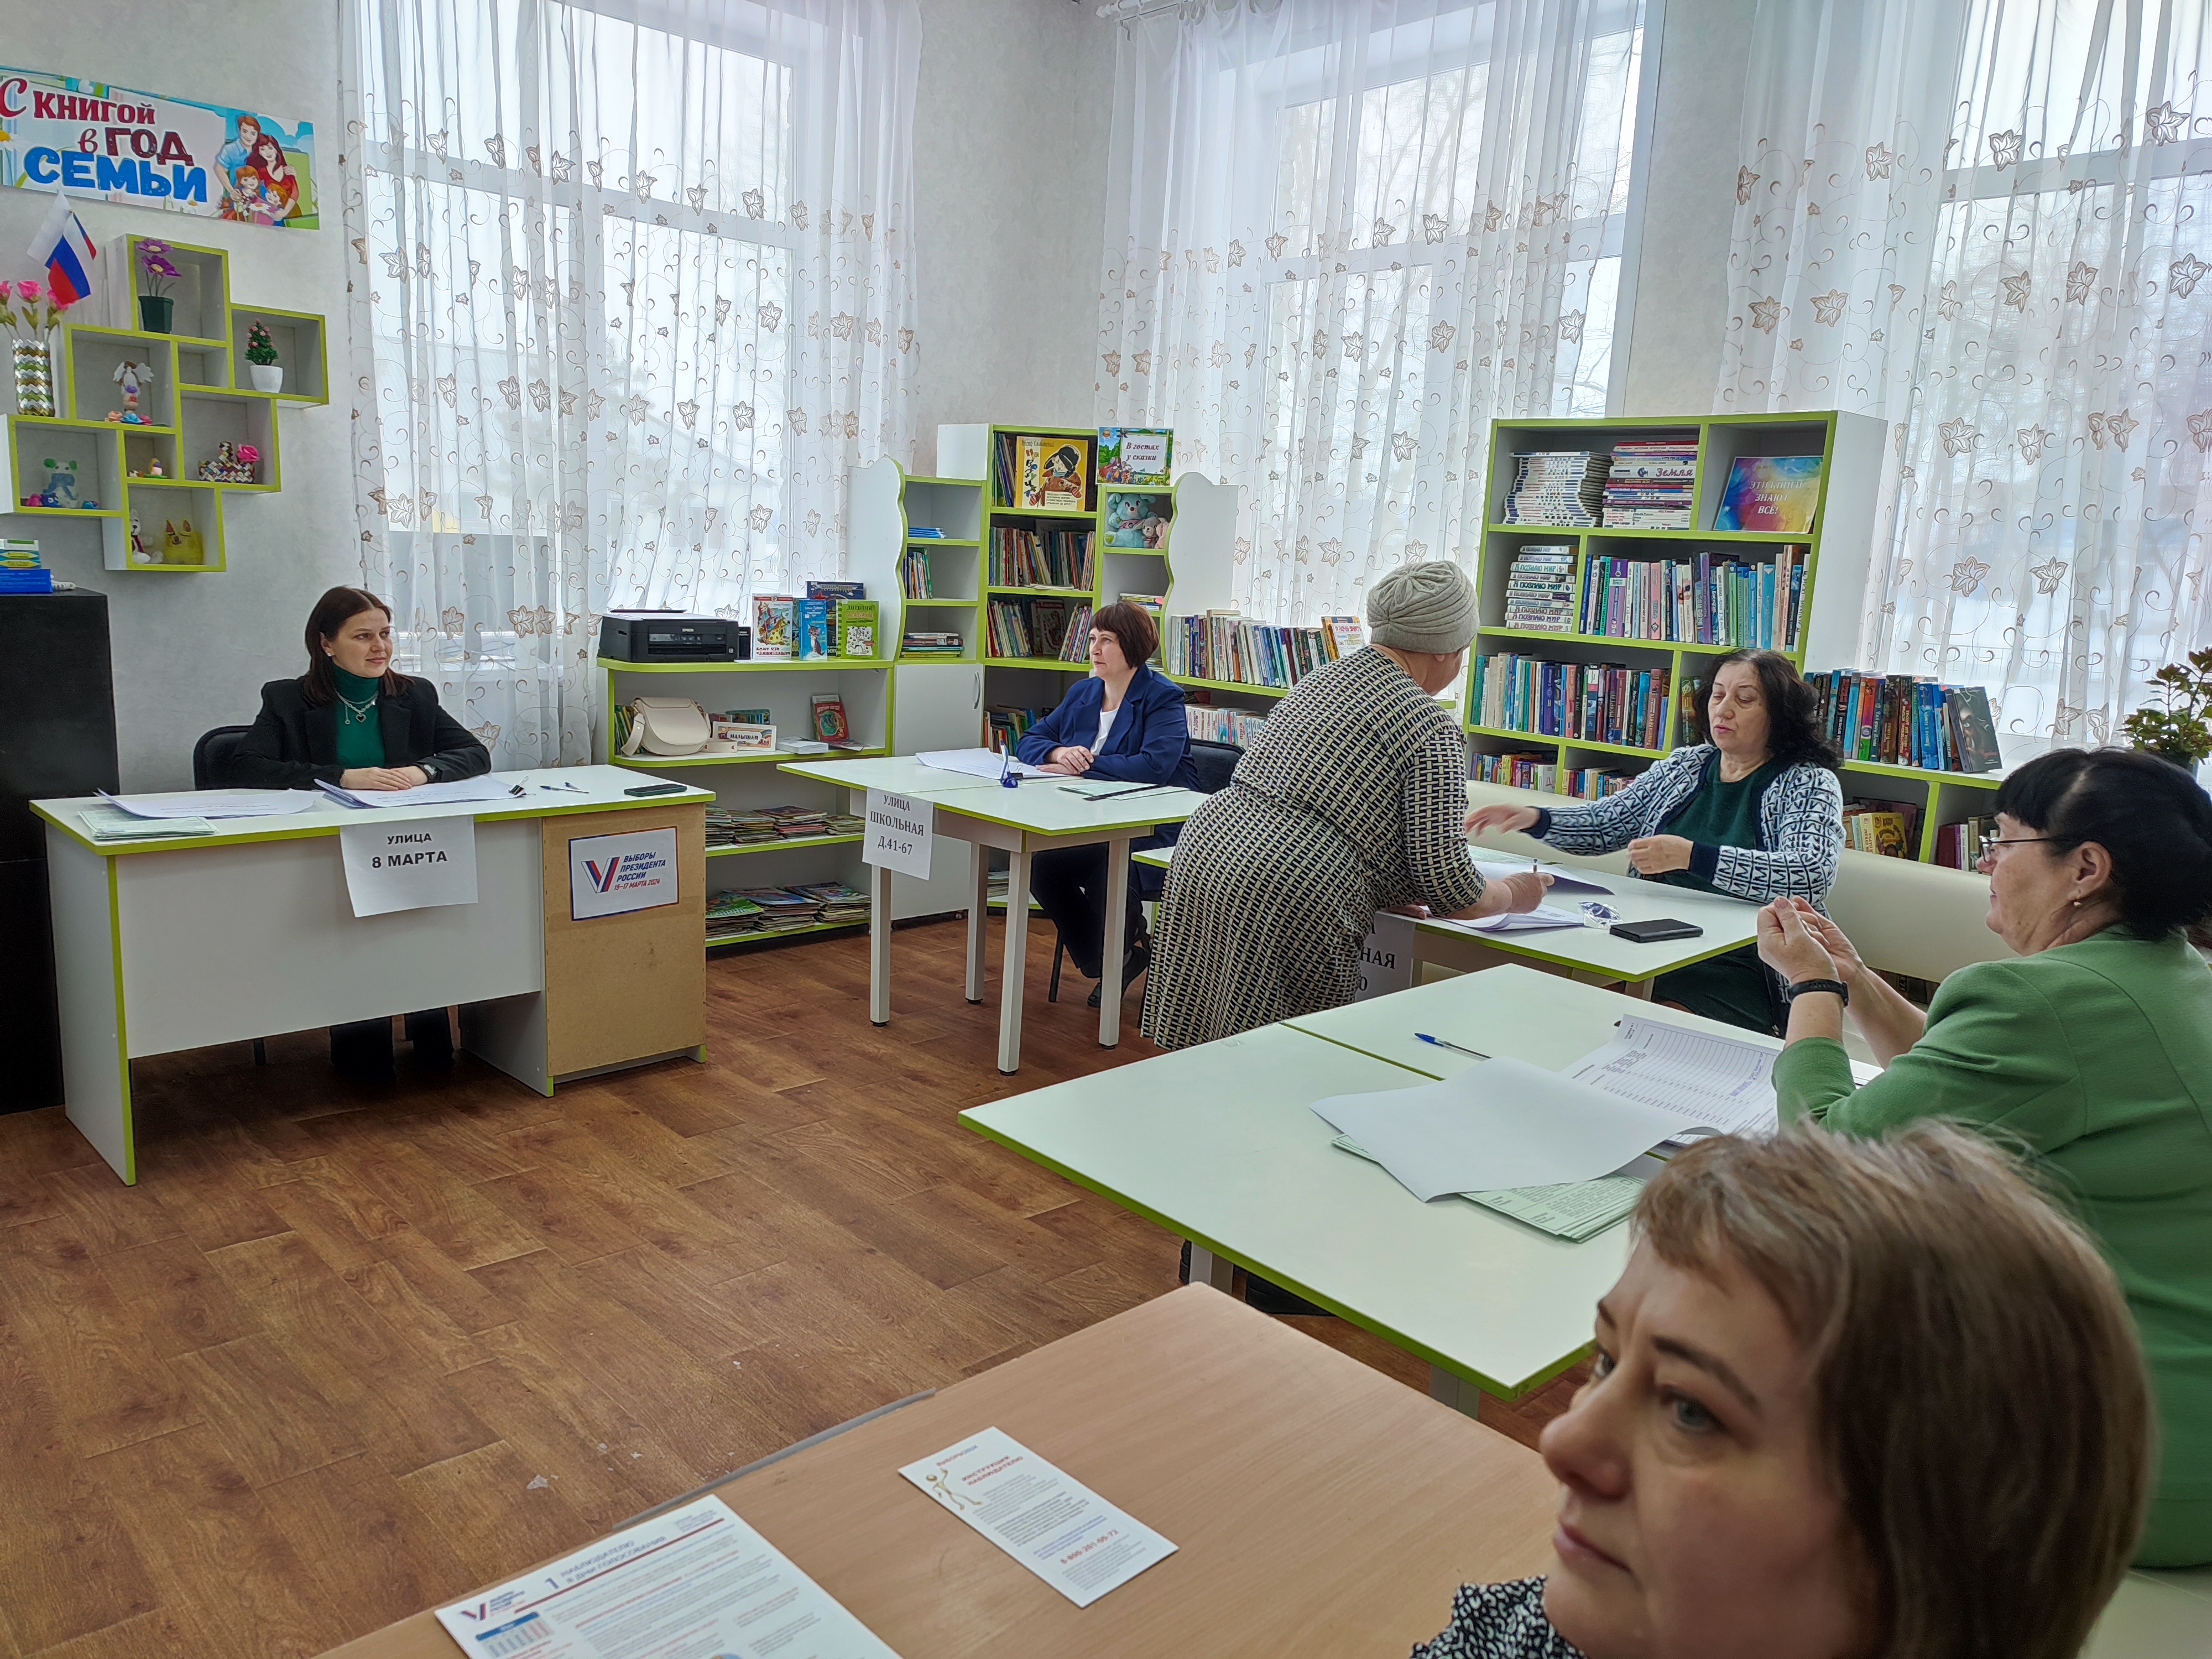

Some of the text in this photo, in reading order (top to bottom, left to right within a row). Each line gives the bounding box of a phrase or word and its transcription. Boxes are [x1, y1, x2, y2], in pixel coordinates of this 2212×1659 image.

[0, 78, 156, 125] С КНИГОЙ
[77, 127, 194, 166] в ГОД
[24, 147, 208, 203] СЕМЬИ
[1133, 443, 1160, 452] гостях
[1126, 453, 1157, 462] у сказки
[1655, 467, 1693, 477] Земля
[1750, 481, 1767, 489] ЭТИ
[1755, 493, 1788, 502] ЗНАЮТ
[883, 794, 911, 812] УЛИЦА
[870, 810, 924, 837] ШКОЛЬНАЯ
[387, 833, 432, 845] УЛИЦА
[878, 835, 913, 855] Д.41-67
[372, 851, 448, 869] 8 МАРТА
[623, 852, 656, 863] ВЫБОРЫ
[620, 859, 666, 873] ПРЕЗИДЕНТА
[617, 872, 648, 882] РОССИИ
[629, 880, 647, 889] МАРТА
[648, 878, 660, 886] 2024
[545, 1577, 559, 1590] 1
